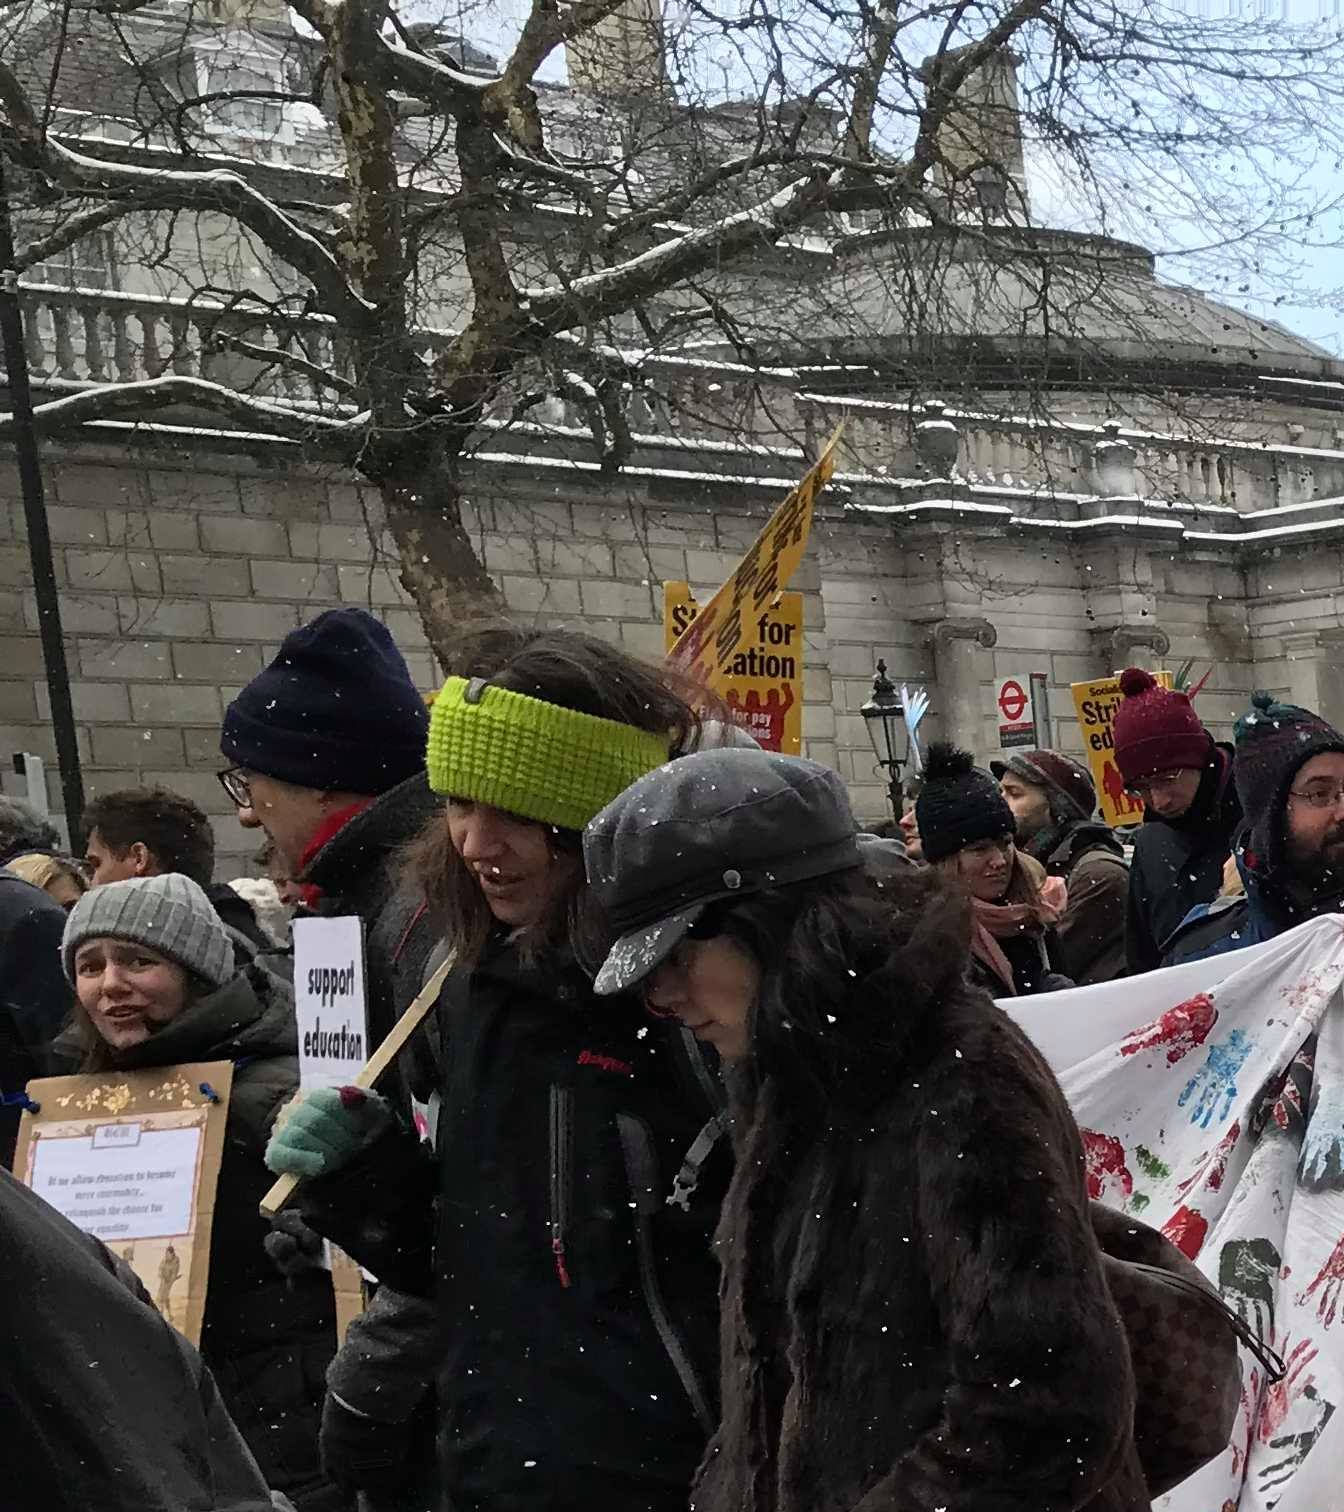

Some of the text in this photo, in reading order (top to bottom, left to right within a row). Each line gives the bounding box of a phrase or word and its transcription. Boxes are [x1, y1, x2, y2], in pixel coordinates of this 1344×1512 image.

[758, 613, 796, 646] for
[752, 712, 772, 728] pay
[308, 960, 354, 1008] support
[303, 1016, 362, 1061] education
